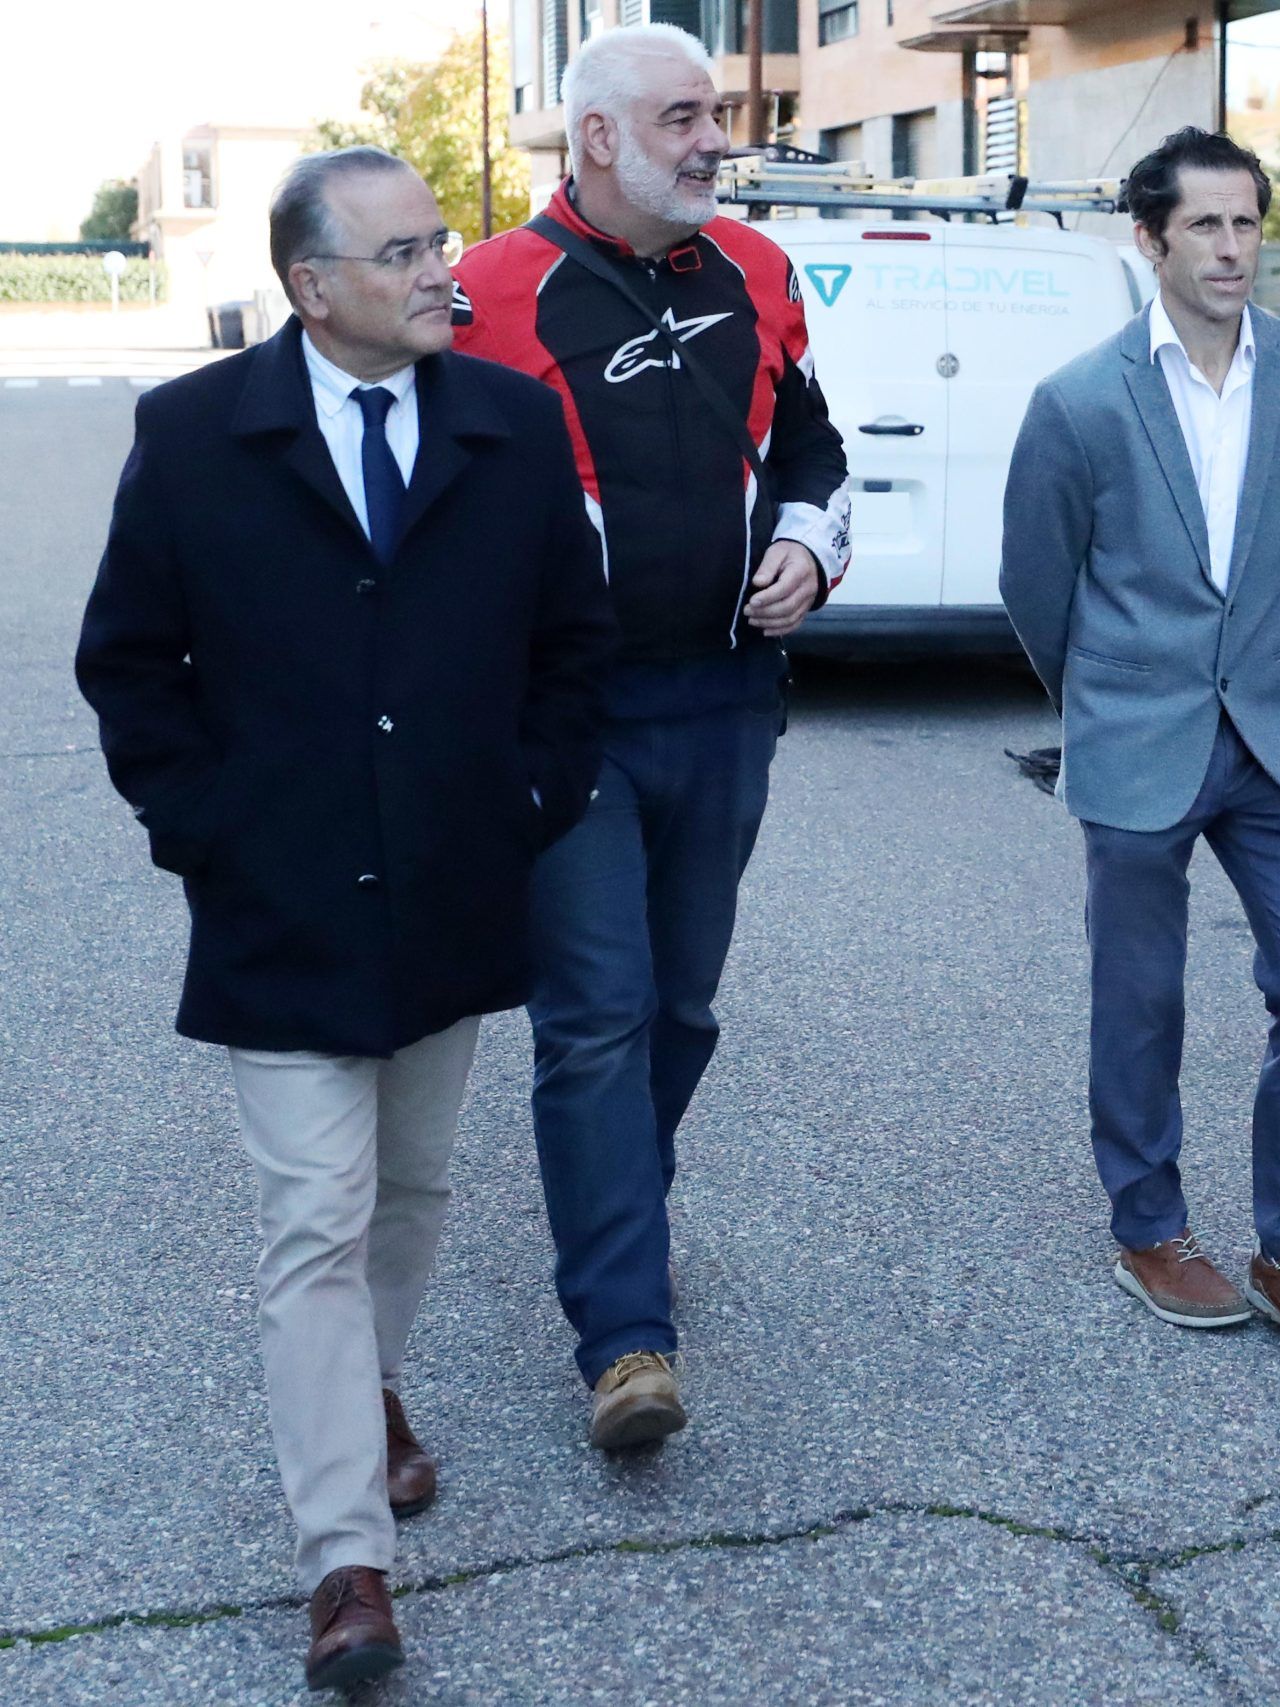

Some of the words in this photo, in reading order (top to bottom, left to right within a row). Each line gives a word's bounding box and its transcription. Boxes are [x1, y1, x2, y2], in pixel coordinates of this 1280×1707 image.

[864, 263, 1072, 297] TRADIVEL
[865, 298, 885, 310] AL
[891, 299, 958, 311] SERVICIO
[961, 300, 983, 312] DE
[987, 301, 1007, 313] TU
